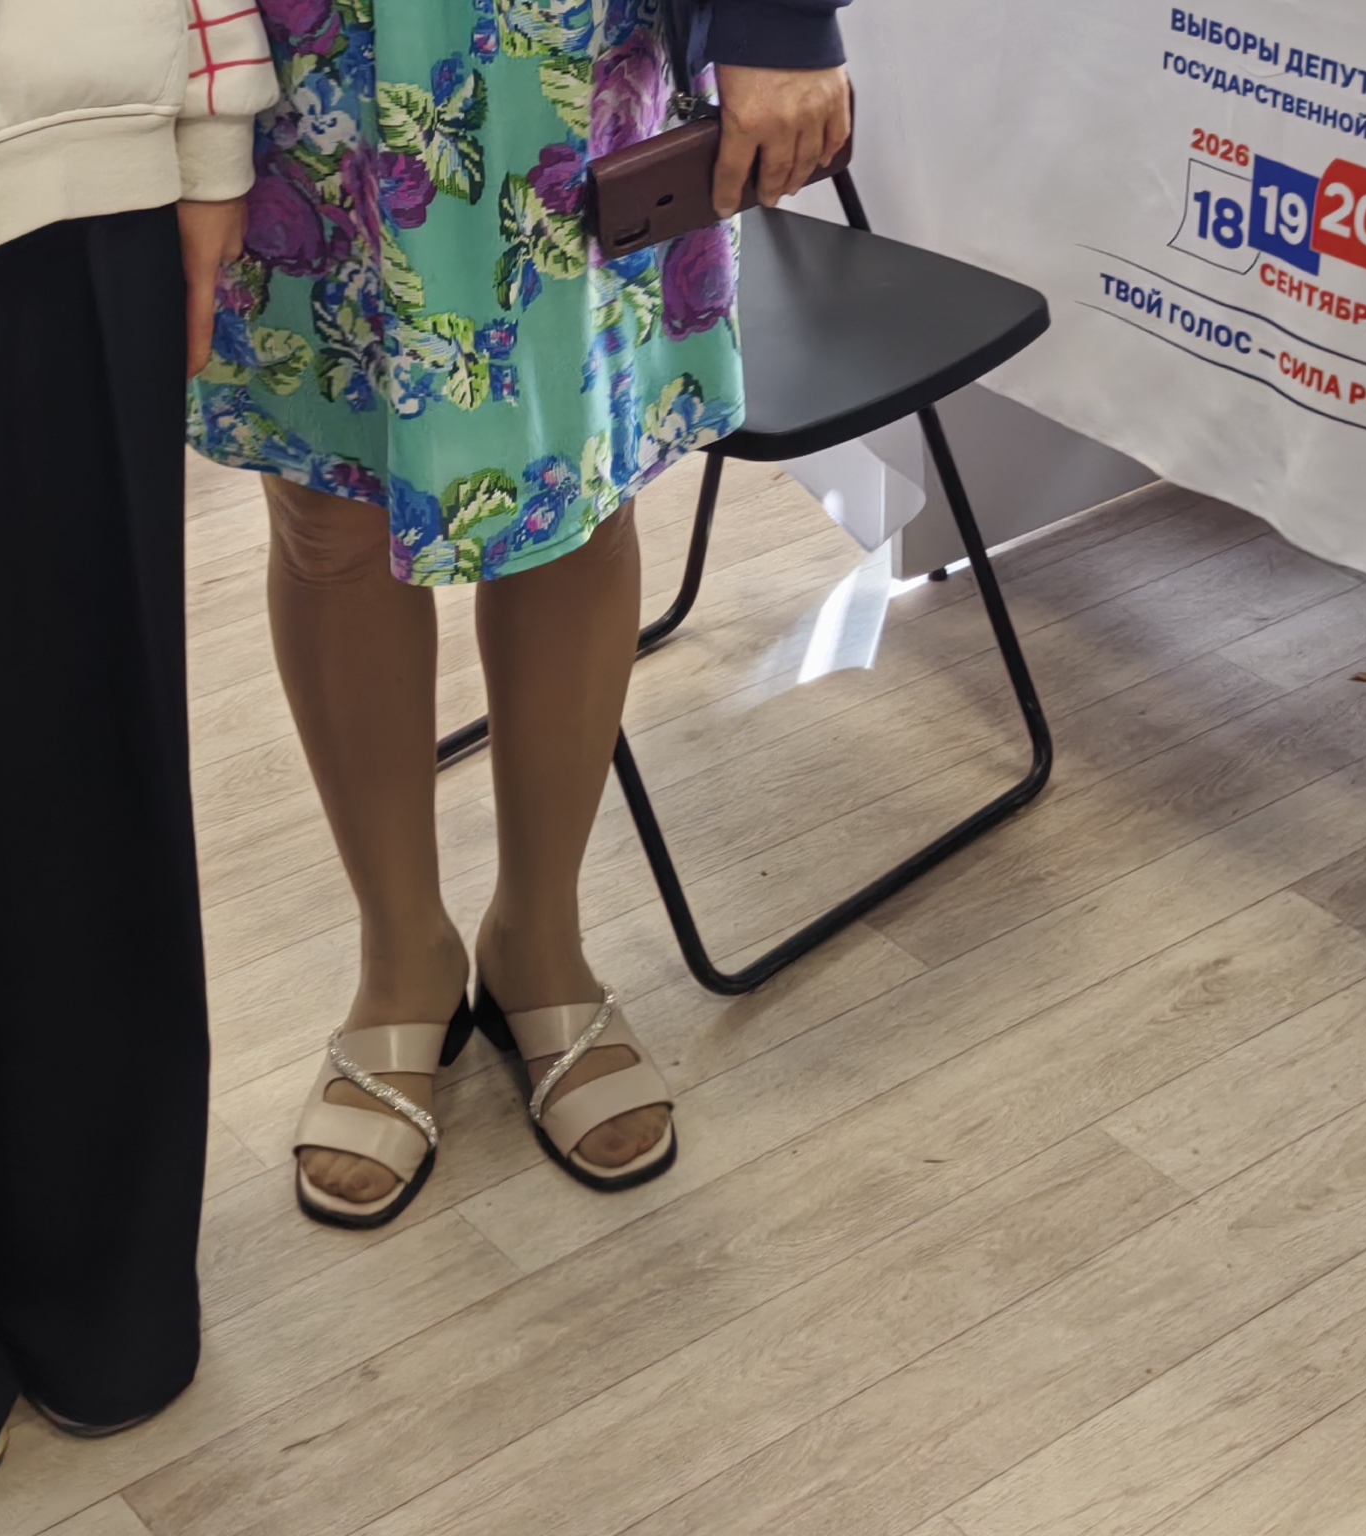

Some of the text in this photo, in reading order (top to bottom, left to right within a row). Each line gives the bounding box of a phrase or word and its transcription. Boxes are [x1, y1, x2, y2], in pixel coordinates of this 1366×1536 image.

[1170, 8, 1280, 66] ВЫБОРЫ
[1190, 127, 1250, 167] 2026
[1193, 189, 1245, 250] 18
[1258, 184, 1309, 246] 19
[1099, 272, 1164, 318] ТВОЙ
[1168, 303, 1253, 355] ГОЛОС
[1277, 350, 1342, 400] СИЛА
